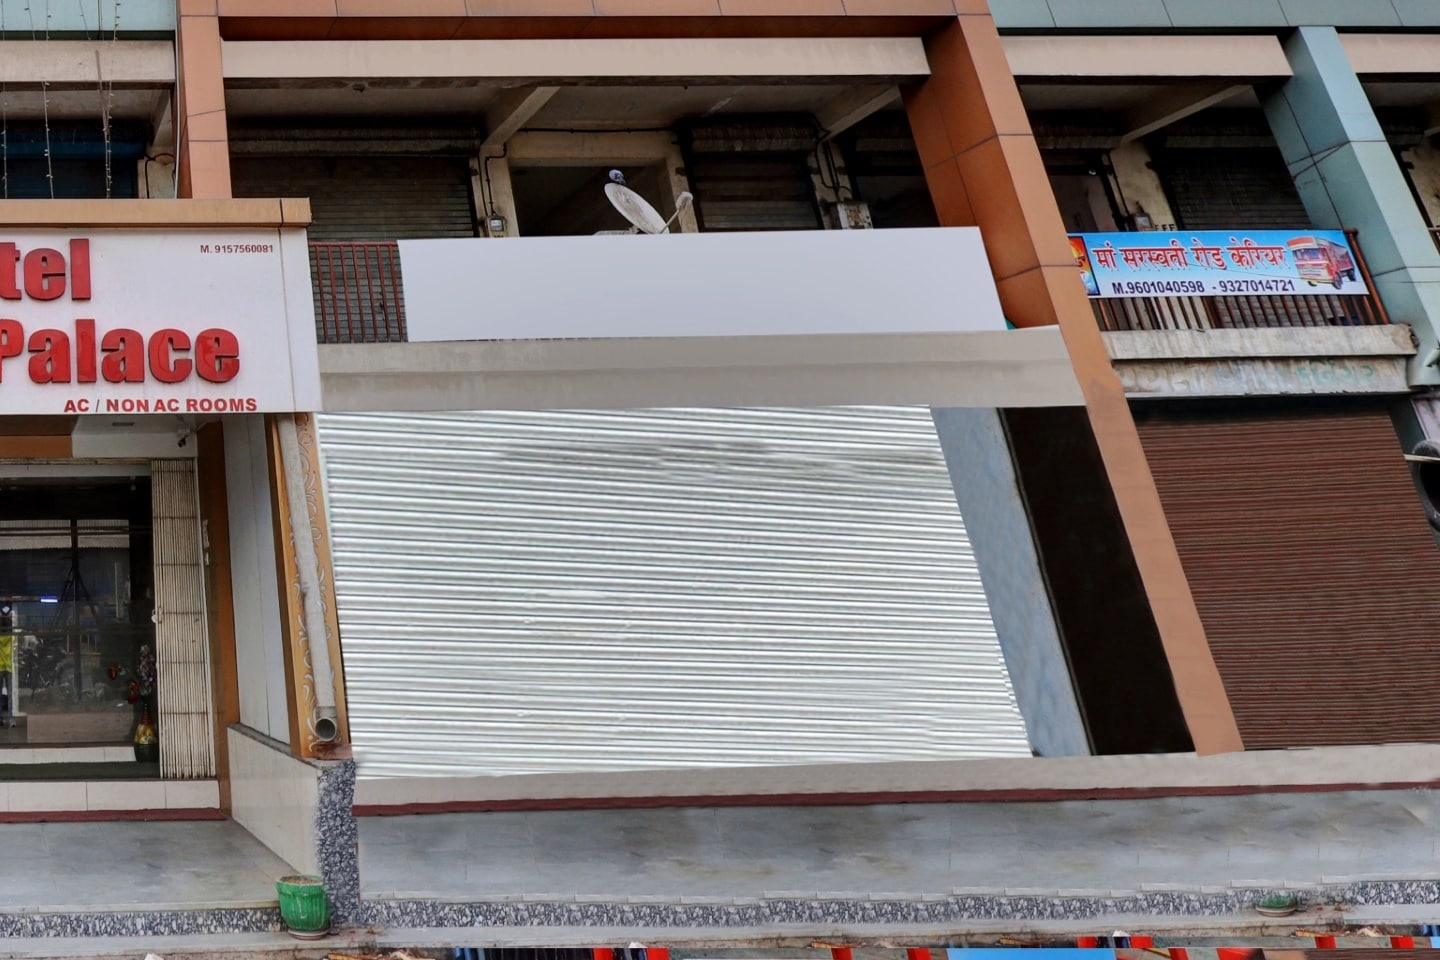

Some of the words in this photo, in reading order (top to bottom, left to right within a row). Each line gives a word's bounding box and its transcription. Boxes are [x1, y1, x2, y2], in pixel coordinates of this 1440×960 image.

[200, 244, 213, 254] M.
[214, 244, 274, 253] 9157560081
[1119, 239, 1190, 270] सरस्वती
[1190, 237, 1227, 270] रोड
[63, 399, 90, 413] AC
[106, 399, 150, 413] NON
[153, 399, 180, 413] AC
[185, 398, 258, 413] ROOMS
